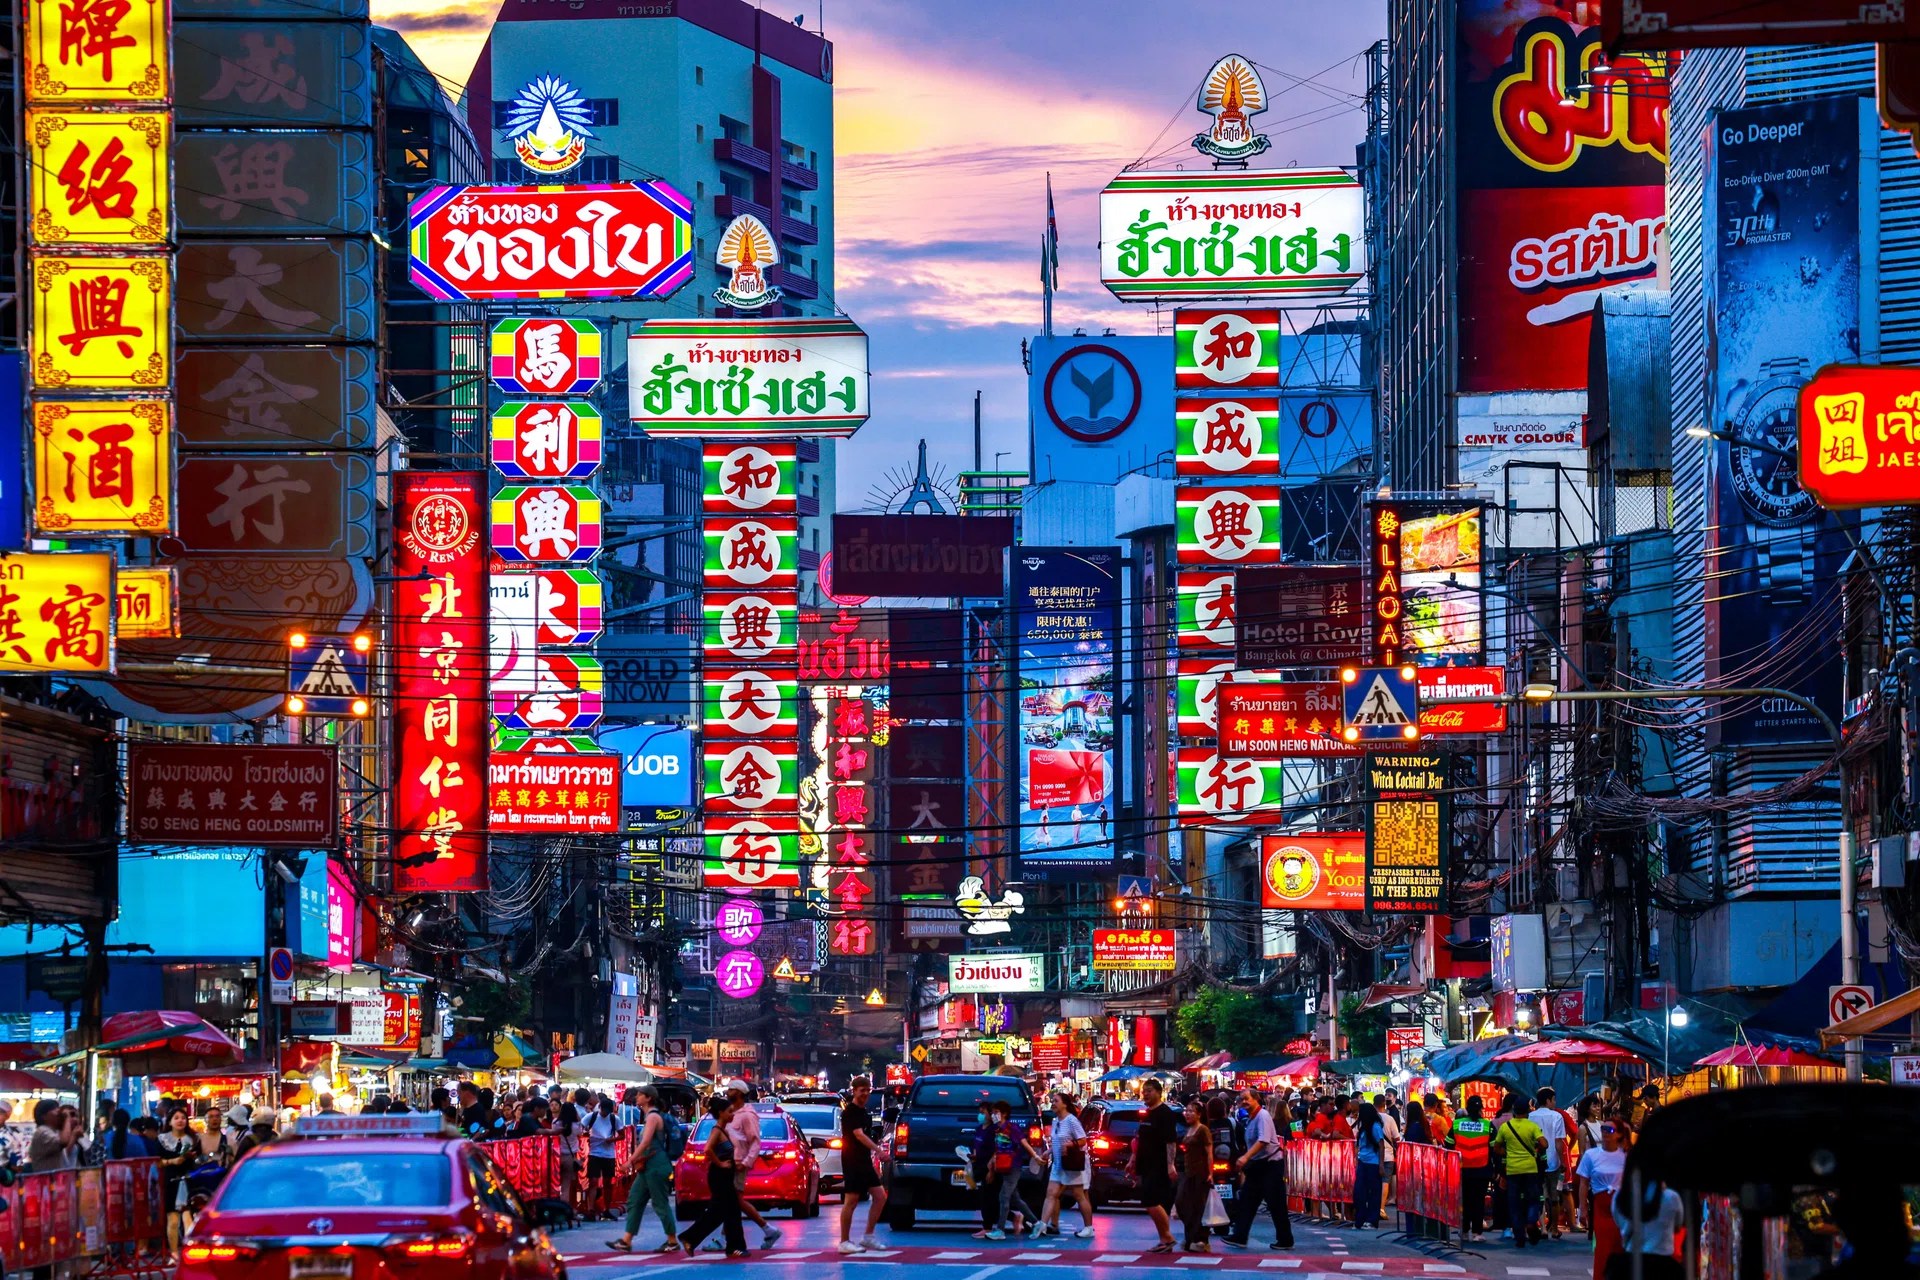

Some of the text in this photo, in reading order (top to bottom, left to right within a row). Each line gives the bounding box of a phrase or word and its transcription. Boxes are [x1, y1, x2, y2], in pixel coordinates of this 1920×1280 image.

[618, 1, 673, 16] ทาวเวอร์
[1722, 121, 1804, 145] Go Deeper
[1725, 165, 1830, 187] Eco-Drive Diver 200m GMT
[447, 195, 559, 225] ห้างทอง
[1166, 196, 1301, 221] ห้างขายทอง
[442, 200, 664, 281] ทองใบ
[1116, 208, 1351, 277] ฮั่วเซ่งเฮง
[1745, 232, 1791, 245] PROMASTER
[688, 342, 802, 364] ห้างขายทอง
[642, 353, 856, 416] ฮั่วเซ่งเฮง
[1493, 422, 1547, 433] โฆษณาติดต่อ
[1824, 400, 1863, 464] 四姐
[1465, 433, 1575, 444] CMYK COLOUR
[433, 504, 446, 545] 同仁堂
[403, 531, 479, 562] TONG REN TANG
[1029, 586, 1100, 597] 通往泰国的门户
[1027, 629, 1075, 640] 650,000
[1244, 622, 1304, 643] Hotel
[724, 453, 777, 878] 和成興大金行
[1245, 650, 1296, 663] Bangkok
[1300, 650, 1313, 662] @
[604, 659, 678, 681] GOLD
[611, 682, 670, 702] NOW
[1230, 696, 1297, 711] ร้านขายยา
[419, 572, 464, 859] 北京同仁堂
[1755, 719, 1779, 727] BETTER
[1781, 718, 1806, 726] STARTS
[1229, 740, 1247, 751] LIM
[1249, 740, 1277, 751] SOON
[1280, 740, 1308, 751] HENG
[627, 755, 679, 776] UOB
[1375, 757, 1430, 767] WARNING
[141, 764, 233, 784] ห้างขายทอง
[1371, 770, 1443, 790] Witch Cocktail Bar
[140, 818, 325, 833] SO SENG HENG GOLDSMITH
[628, 812, 641, 821] 28
[1370, 876, 1443, 885] USED AS INGREDIENTS
[1373, 869, 1414, 877] TRESPASSERS
[1373, 886, 1440, 897] IN THE BREW
[1118, 931, 1151, 944] กิมจี้
